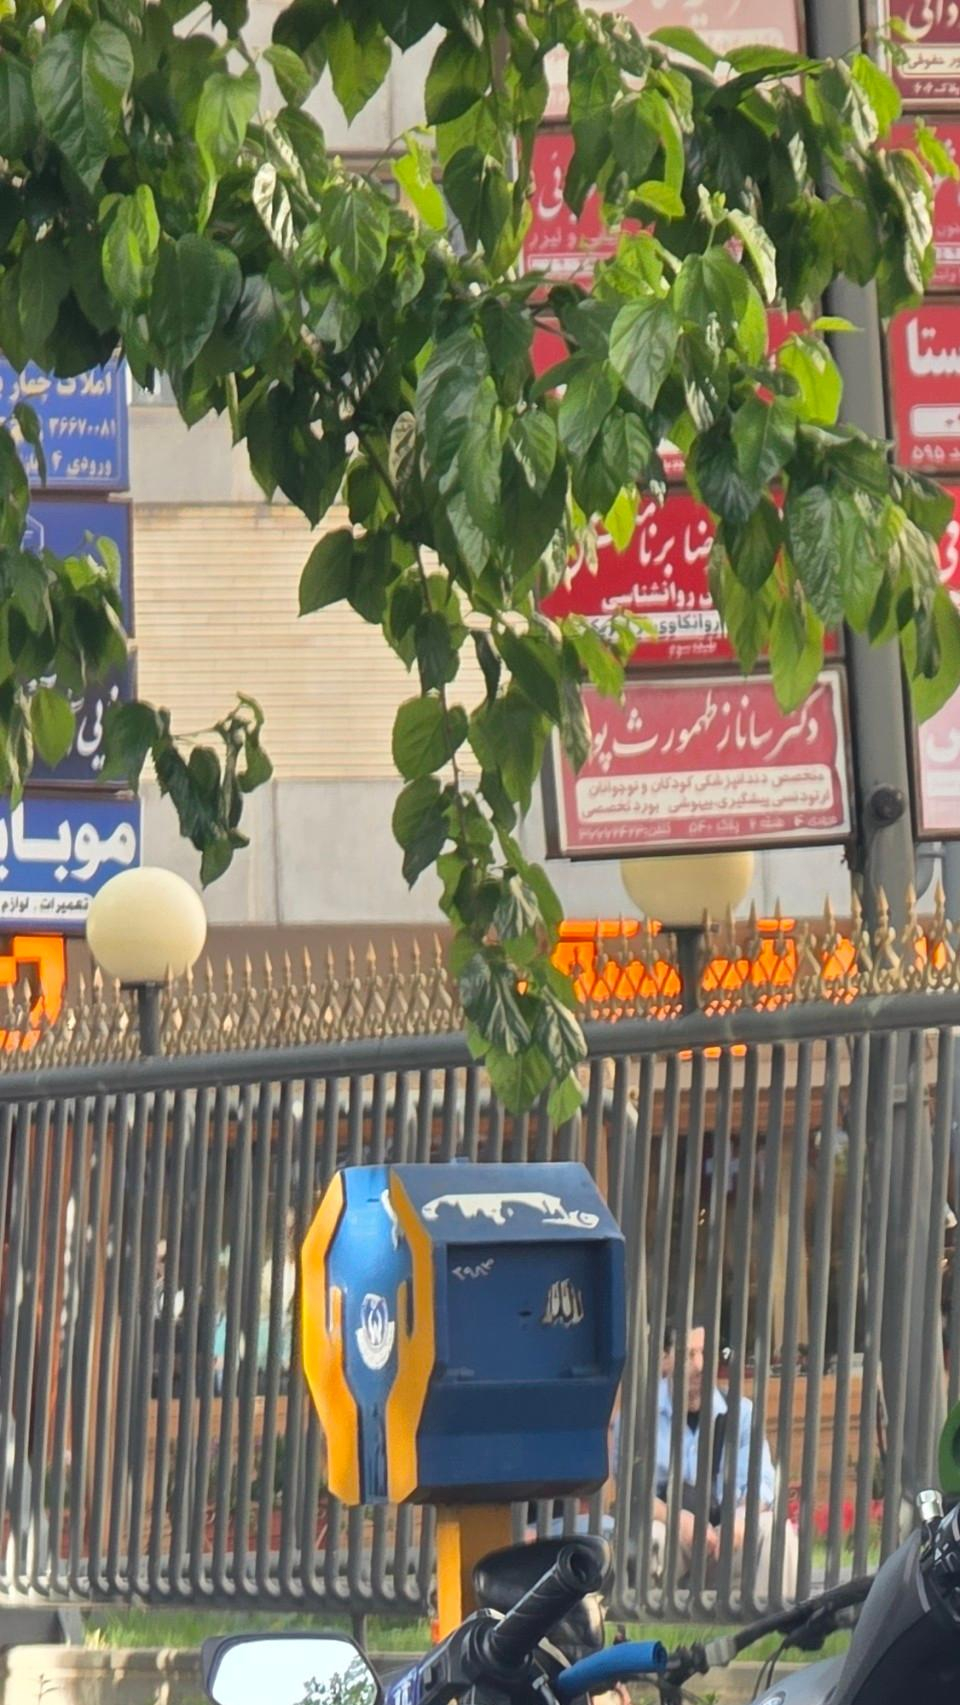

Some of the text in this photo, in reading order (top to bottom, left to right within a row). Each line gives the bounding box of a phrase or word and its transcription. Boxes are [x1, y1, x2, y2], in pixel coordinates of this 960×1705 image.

[67, 456, 112, 478] ورودی
[683, 520, 715, 566] ضا
[602, 581, 695, 612] روانشناسی
[716, 694, 774, 752] ساناز
[589, 721, 613, 774] پو
